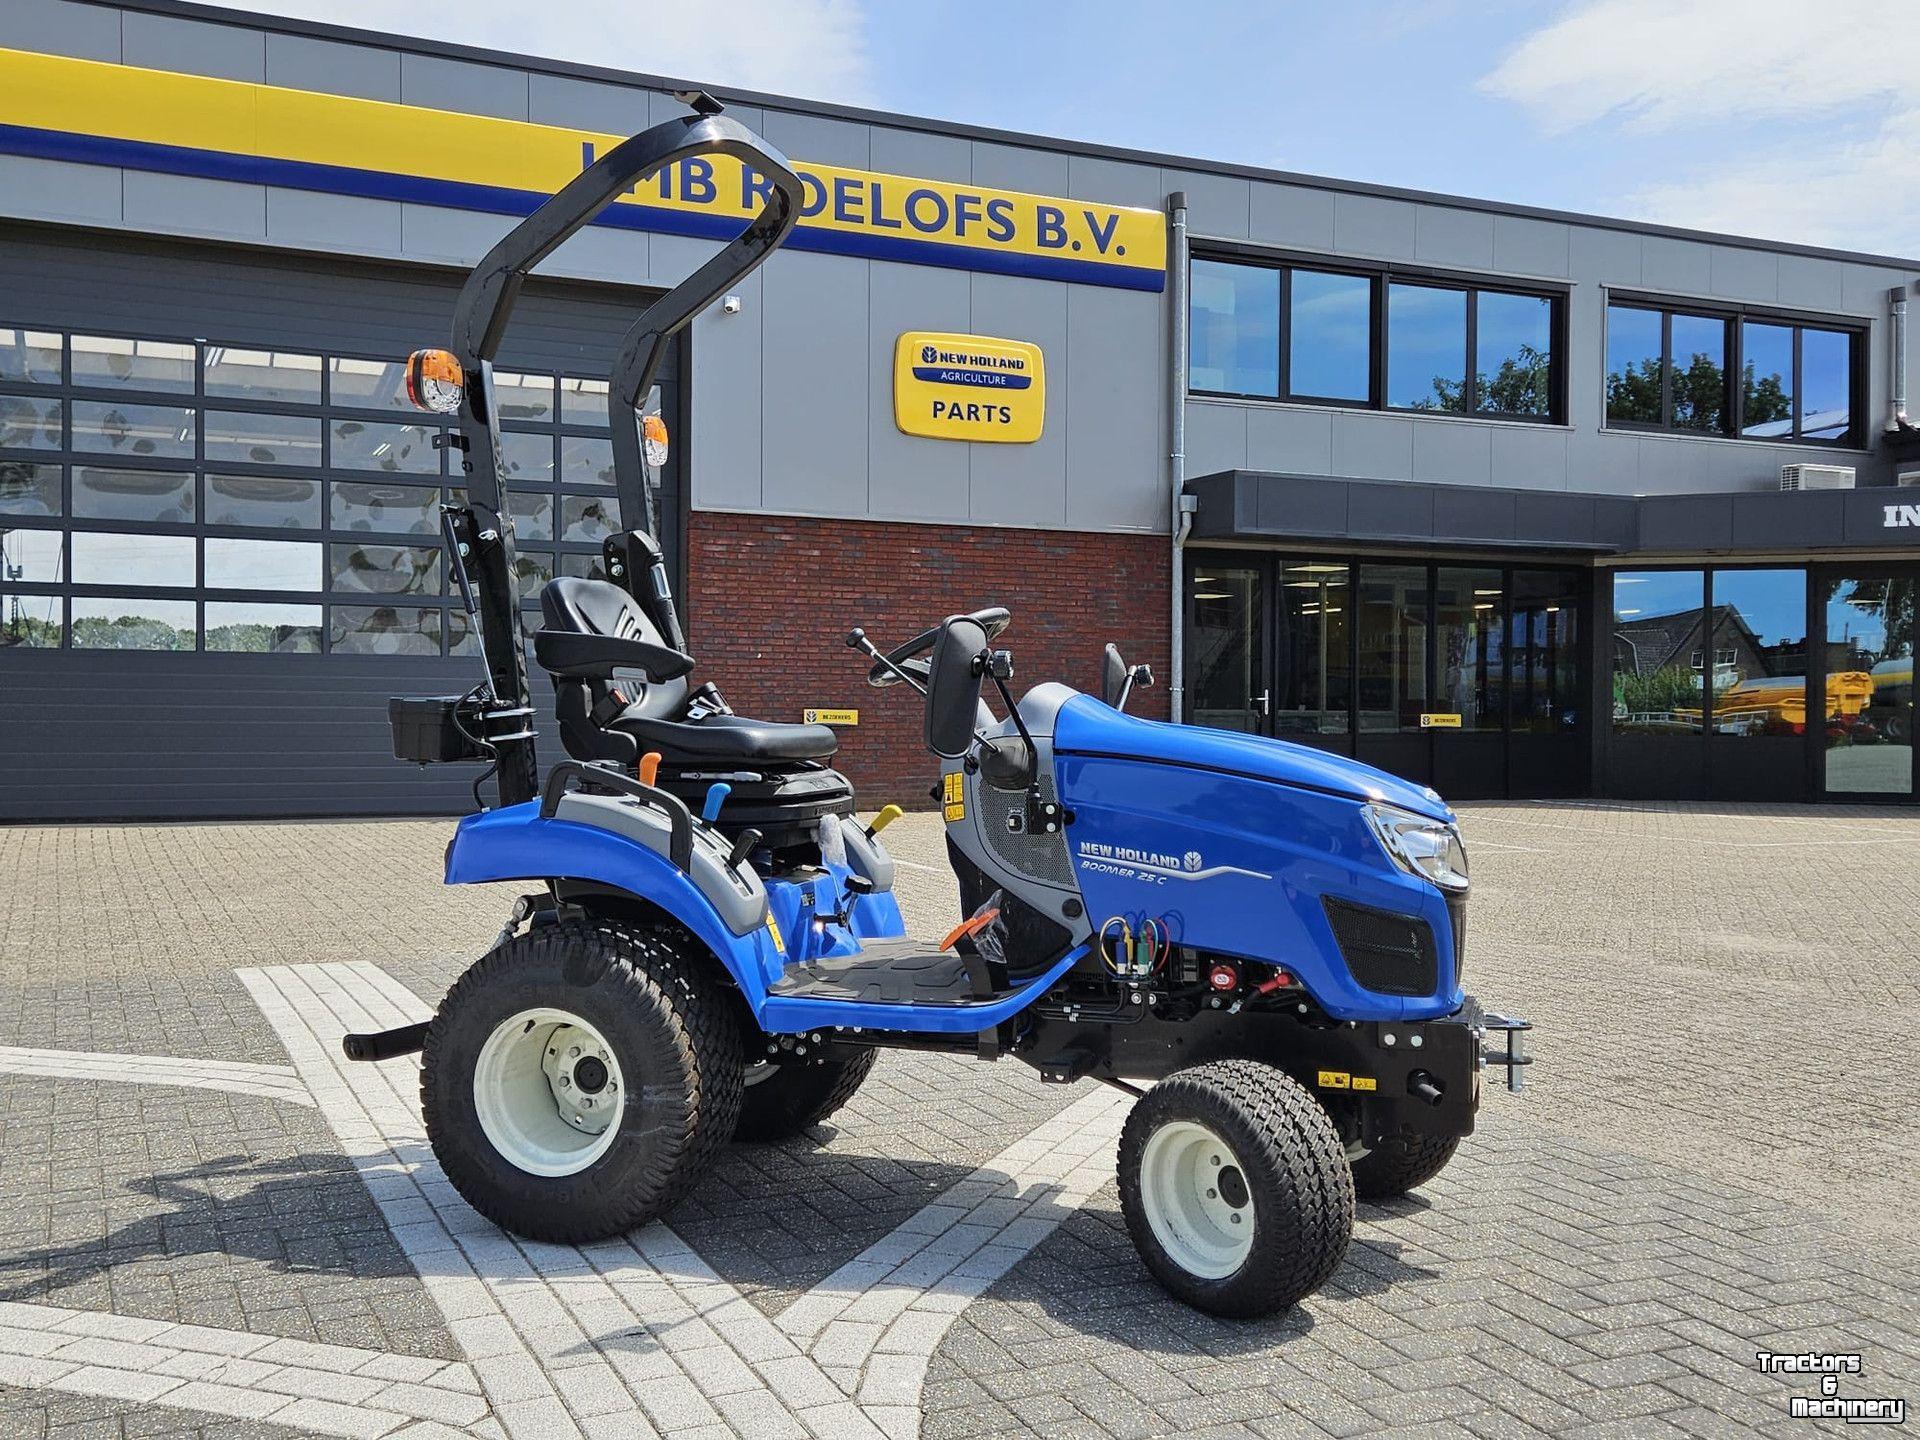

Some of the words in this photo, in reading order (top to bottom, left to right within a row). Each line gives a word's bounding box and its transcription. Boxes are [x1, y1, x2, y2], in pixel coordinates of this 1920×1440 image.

[1036, 205, 1126, 256] B.V.
[939, 352, 968, 365] NEW
[969, 355, 1025, 370] HOLLAND
[940, 371, 1006, 386] AGRICULTURE
[932, 400, 1012, 424] PARTS
[1080, 841, 1113, 857] NEW
[1115, 846, 1181, 870] HOLLAND
[1080, 860, 1135, 879] BOOMER
[1137, 872, 1156, 883] 25
[1157, 876, 1167, 886] C
